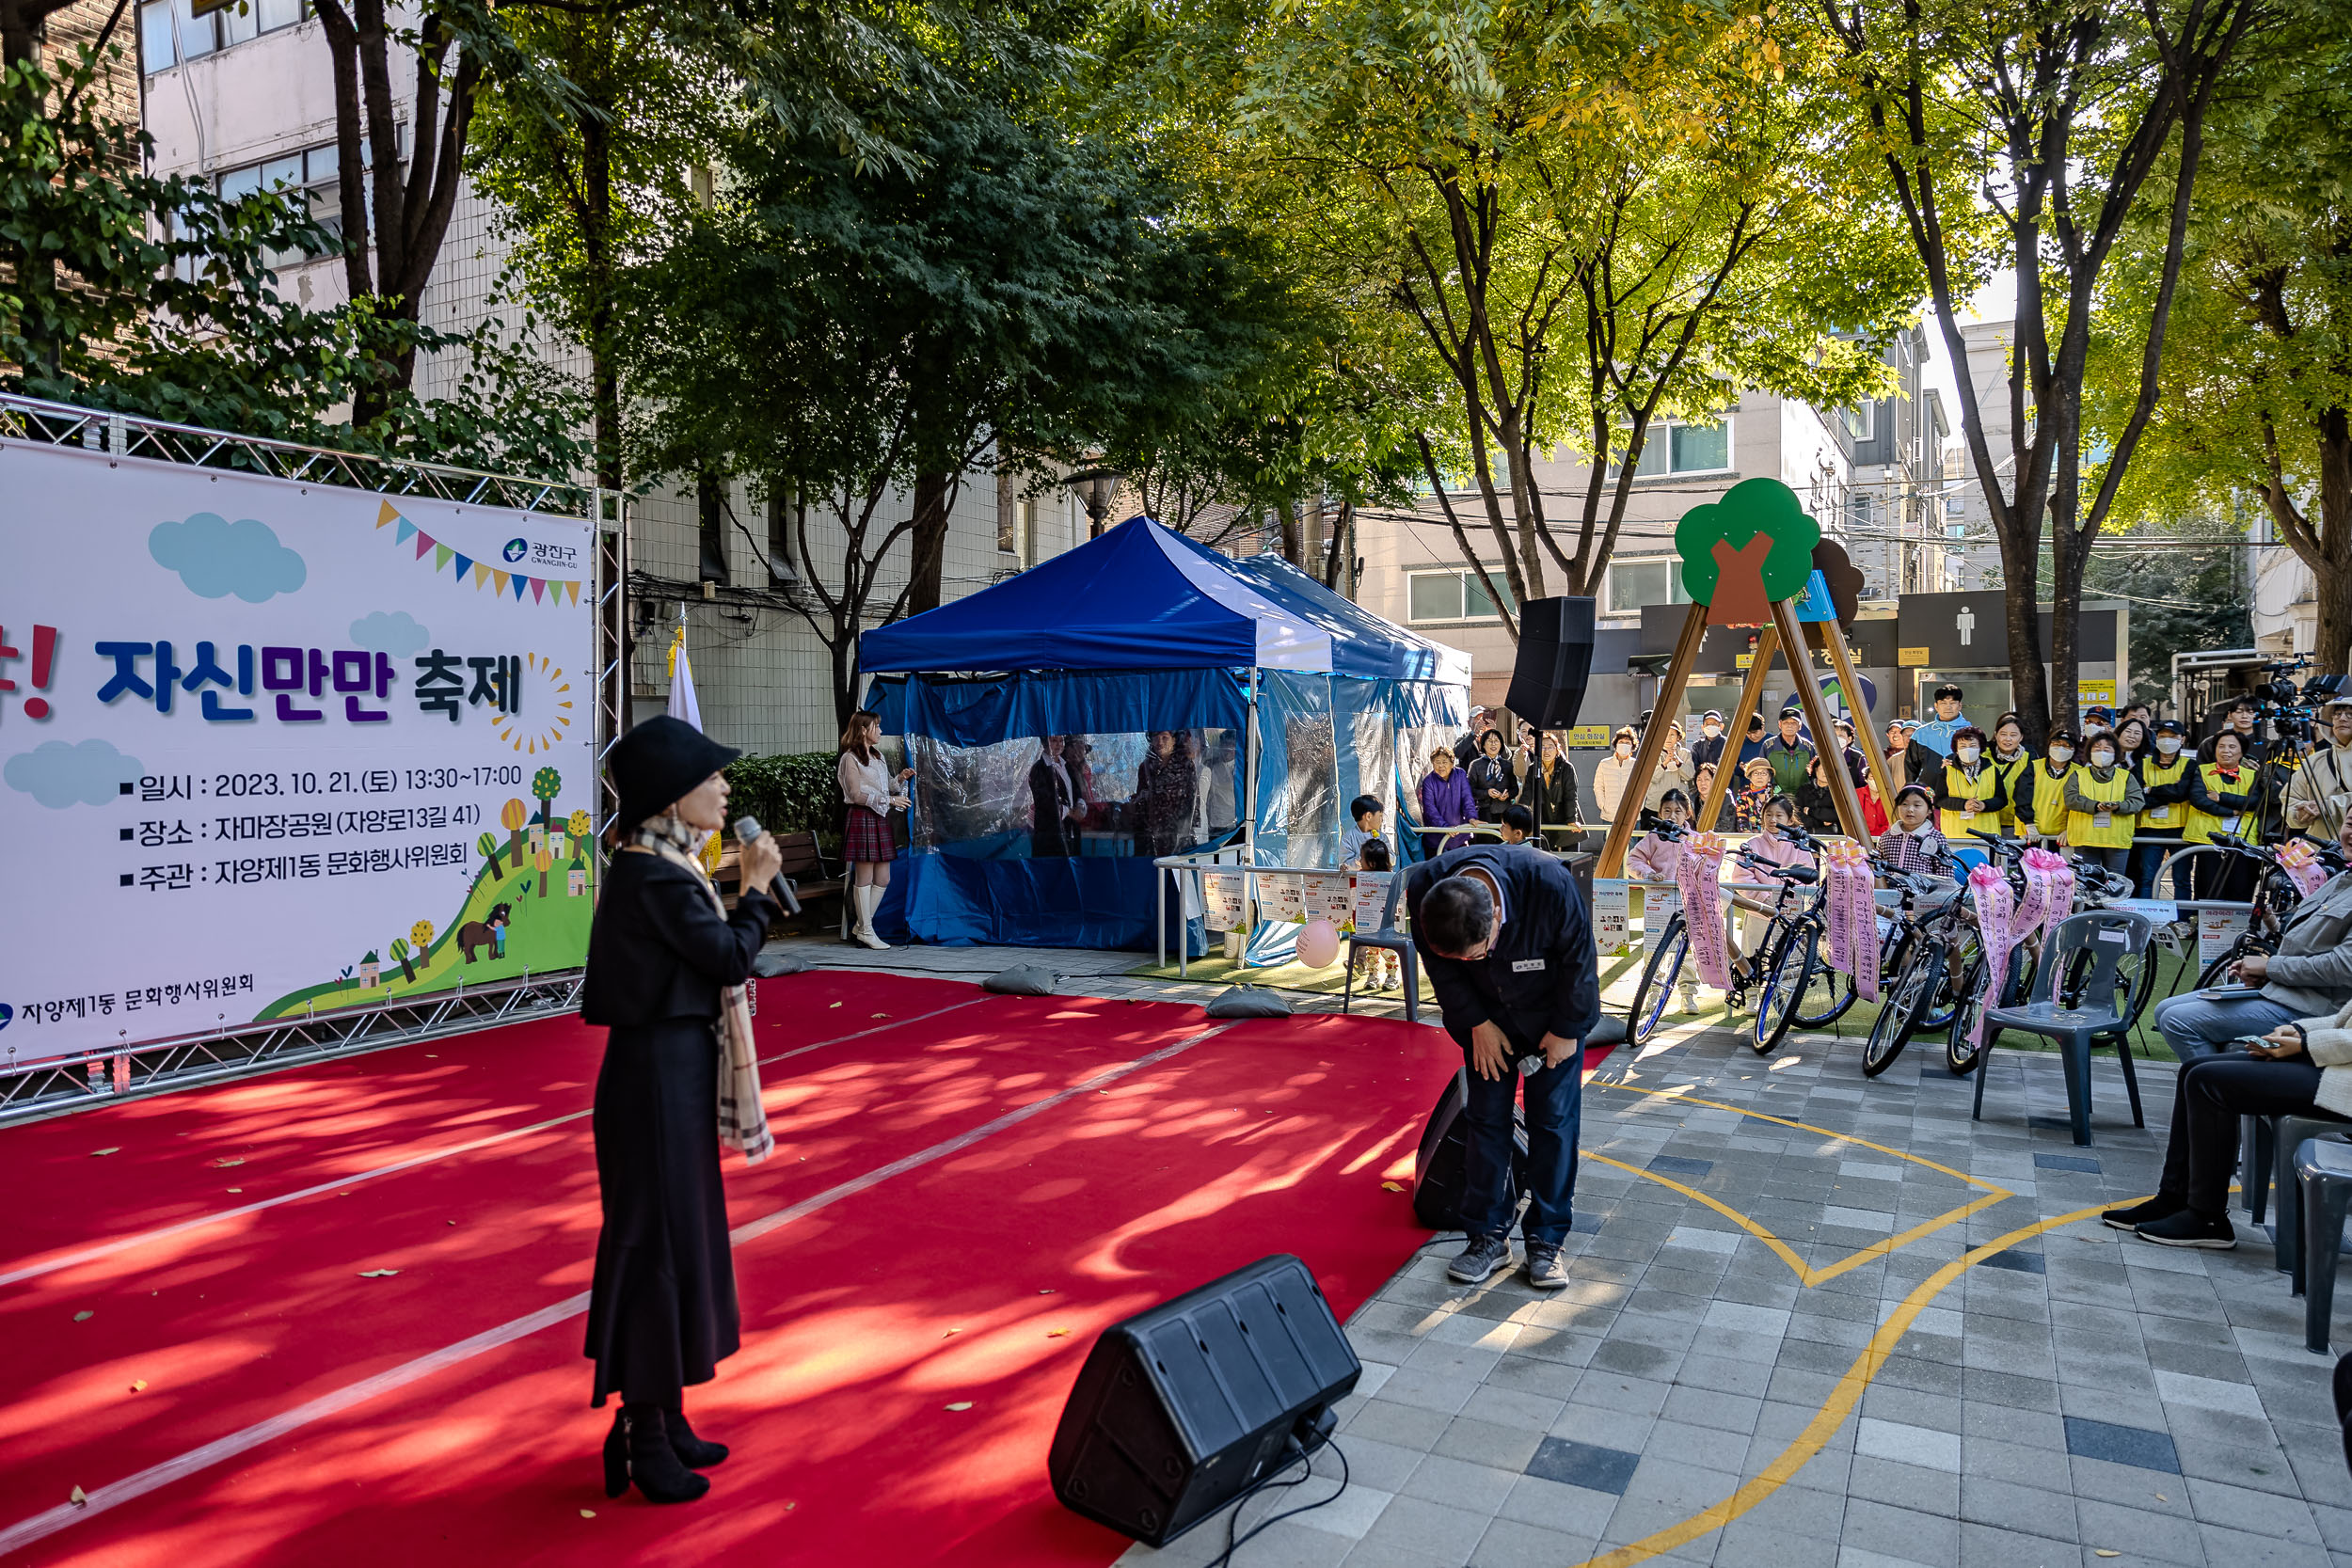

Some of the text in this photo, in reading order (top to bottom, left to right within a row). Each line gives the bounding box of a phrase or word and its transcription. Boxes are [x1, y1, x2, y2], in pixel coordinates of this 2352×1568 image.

[531, 556, 578, 569] GWANGJIN-GU
[532, 542, 578, 561] 광진구
[95, 641, 395, 721] 자신만만
[415, 649, 520, 722] 축제
[139, 775, 192, 801] 일시
[215, 773, 284, 797] 2023.
[292, 772, 323, 794] 10.
[405, 766, 522, 790] 13:30~17:00
[139, 820, 193, 847] 장소
[453, 803, 481, 826] 41)
[139, 863, 194, 892] 주관
[215, 854, 322, 884] 자양제1동
[326, 842, 468, 877] 문화행사위원회
[1995, 897, 2007, 919] 제3회
[22, 974, 254, 1024] 자양제1동 문화행사위원회
